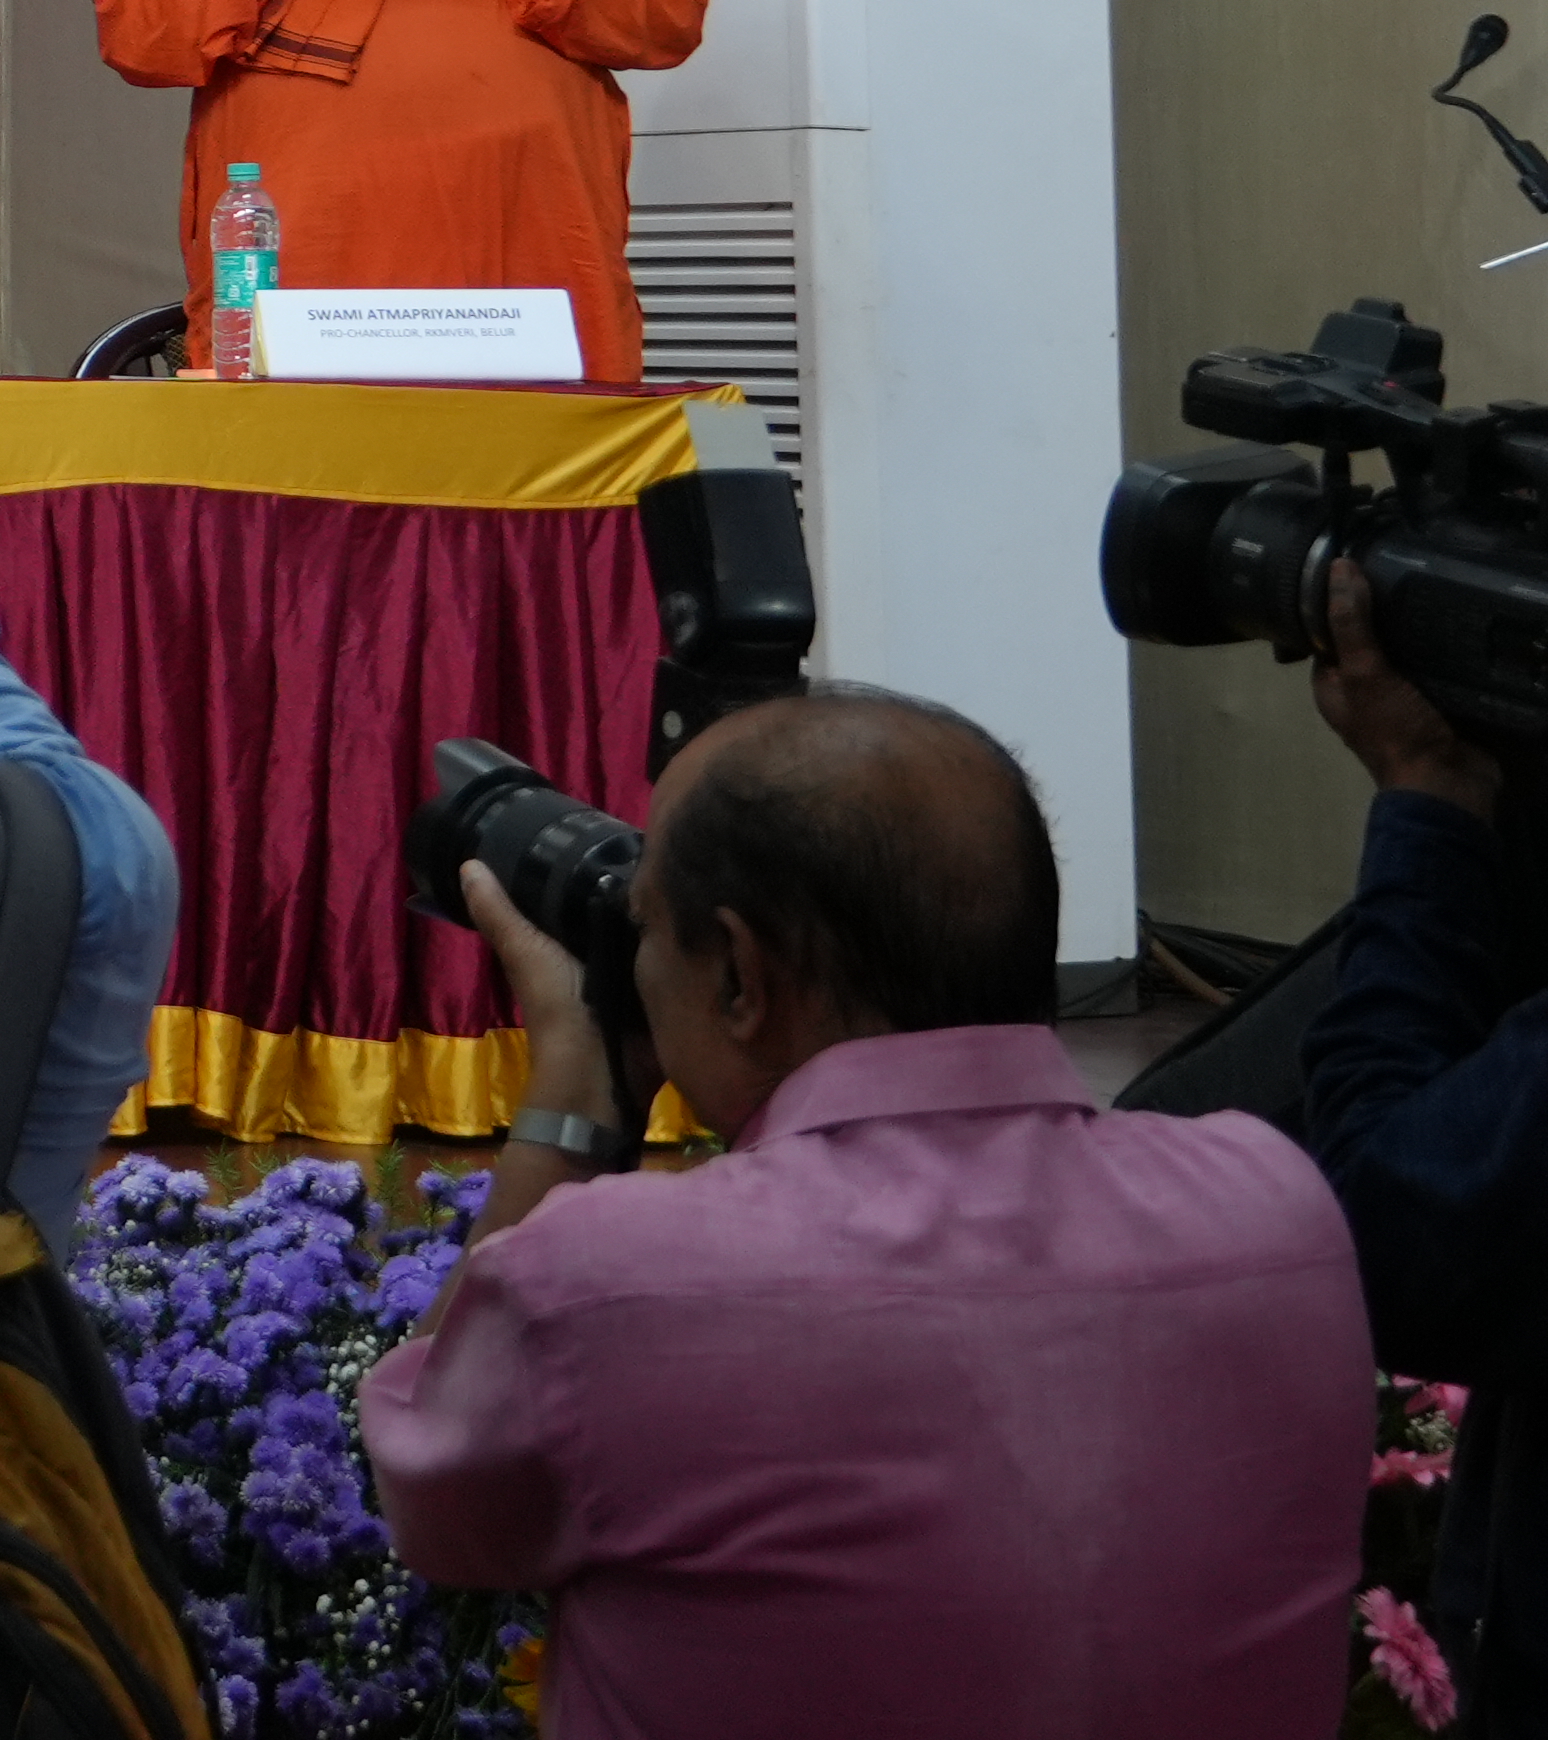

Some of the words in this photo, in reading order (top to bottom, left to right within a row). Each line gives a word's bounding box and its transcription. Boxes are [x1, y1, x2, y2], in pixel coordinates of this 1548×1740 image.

[307, 309, 363, 320] SWAMI
[367, 308, 522, 320] ATMAPRIYANANDAJI
[320, 328, 421, 338] PRO-CHANCELLOR,
[480, 327, 516, 337] BELUR
